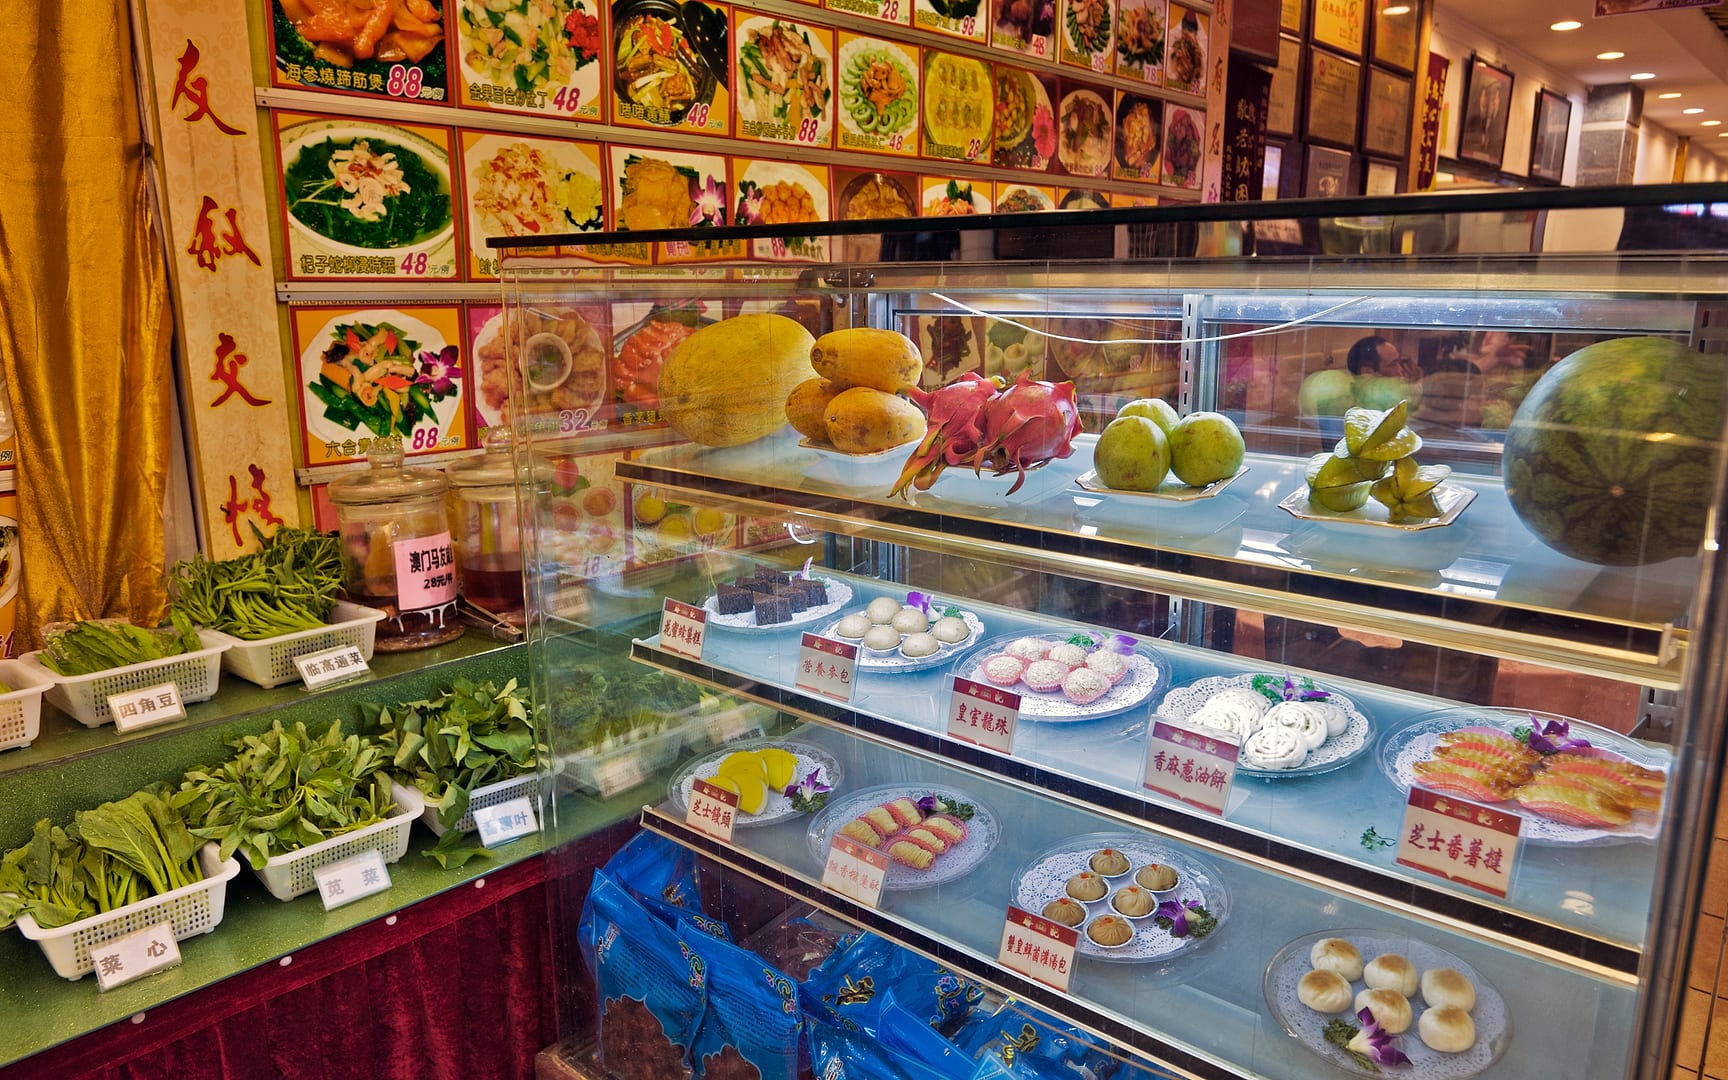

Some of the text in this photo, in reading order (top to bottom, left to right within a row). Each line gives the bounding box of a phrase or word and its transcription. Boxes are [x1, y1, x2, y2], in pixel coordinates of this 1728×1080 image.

[881, 0, 899, 20] 28
[961, 15, 976, 36] 98
[1033, 36, 1046, 56] 48
[387, 64, 424, 98] 88
[552, 86, 581, 112] 48
[687, 102, 710, 128] 48
[797, 118, 819, 143] 88
[888, 134, 904, 151] 48
[966, 138, 981, 158] 28
[400, 252, 428, 275] 48
[559, 408, 590, 433] 32
[411, 427, 440, 450] 88
[582, 556, 600, 576] 18
[118, 691, 177, 720] 四角豆
[955, 702, 1009, 737] 皇室龍珠
[1407, 822, 1505, 875] 芝士番薯撻
[324, 867, 381, 898] 苋菜
[98, 938, 169, 978] 菜心
